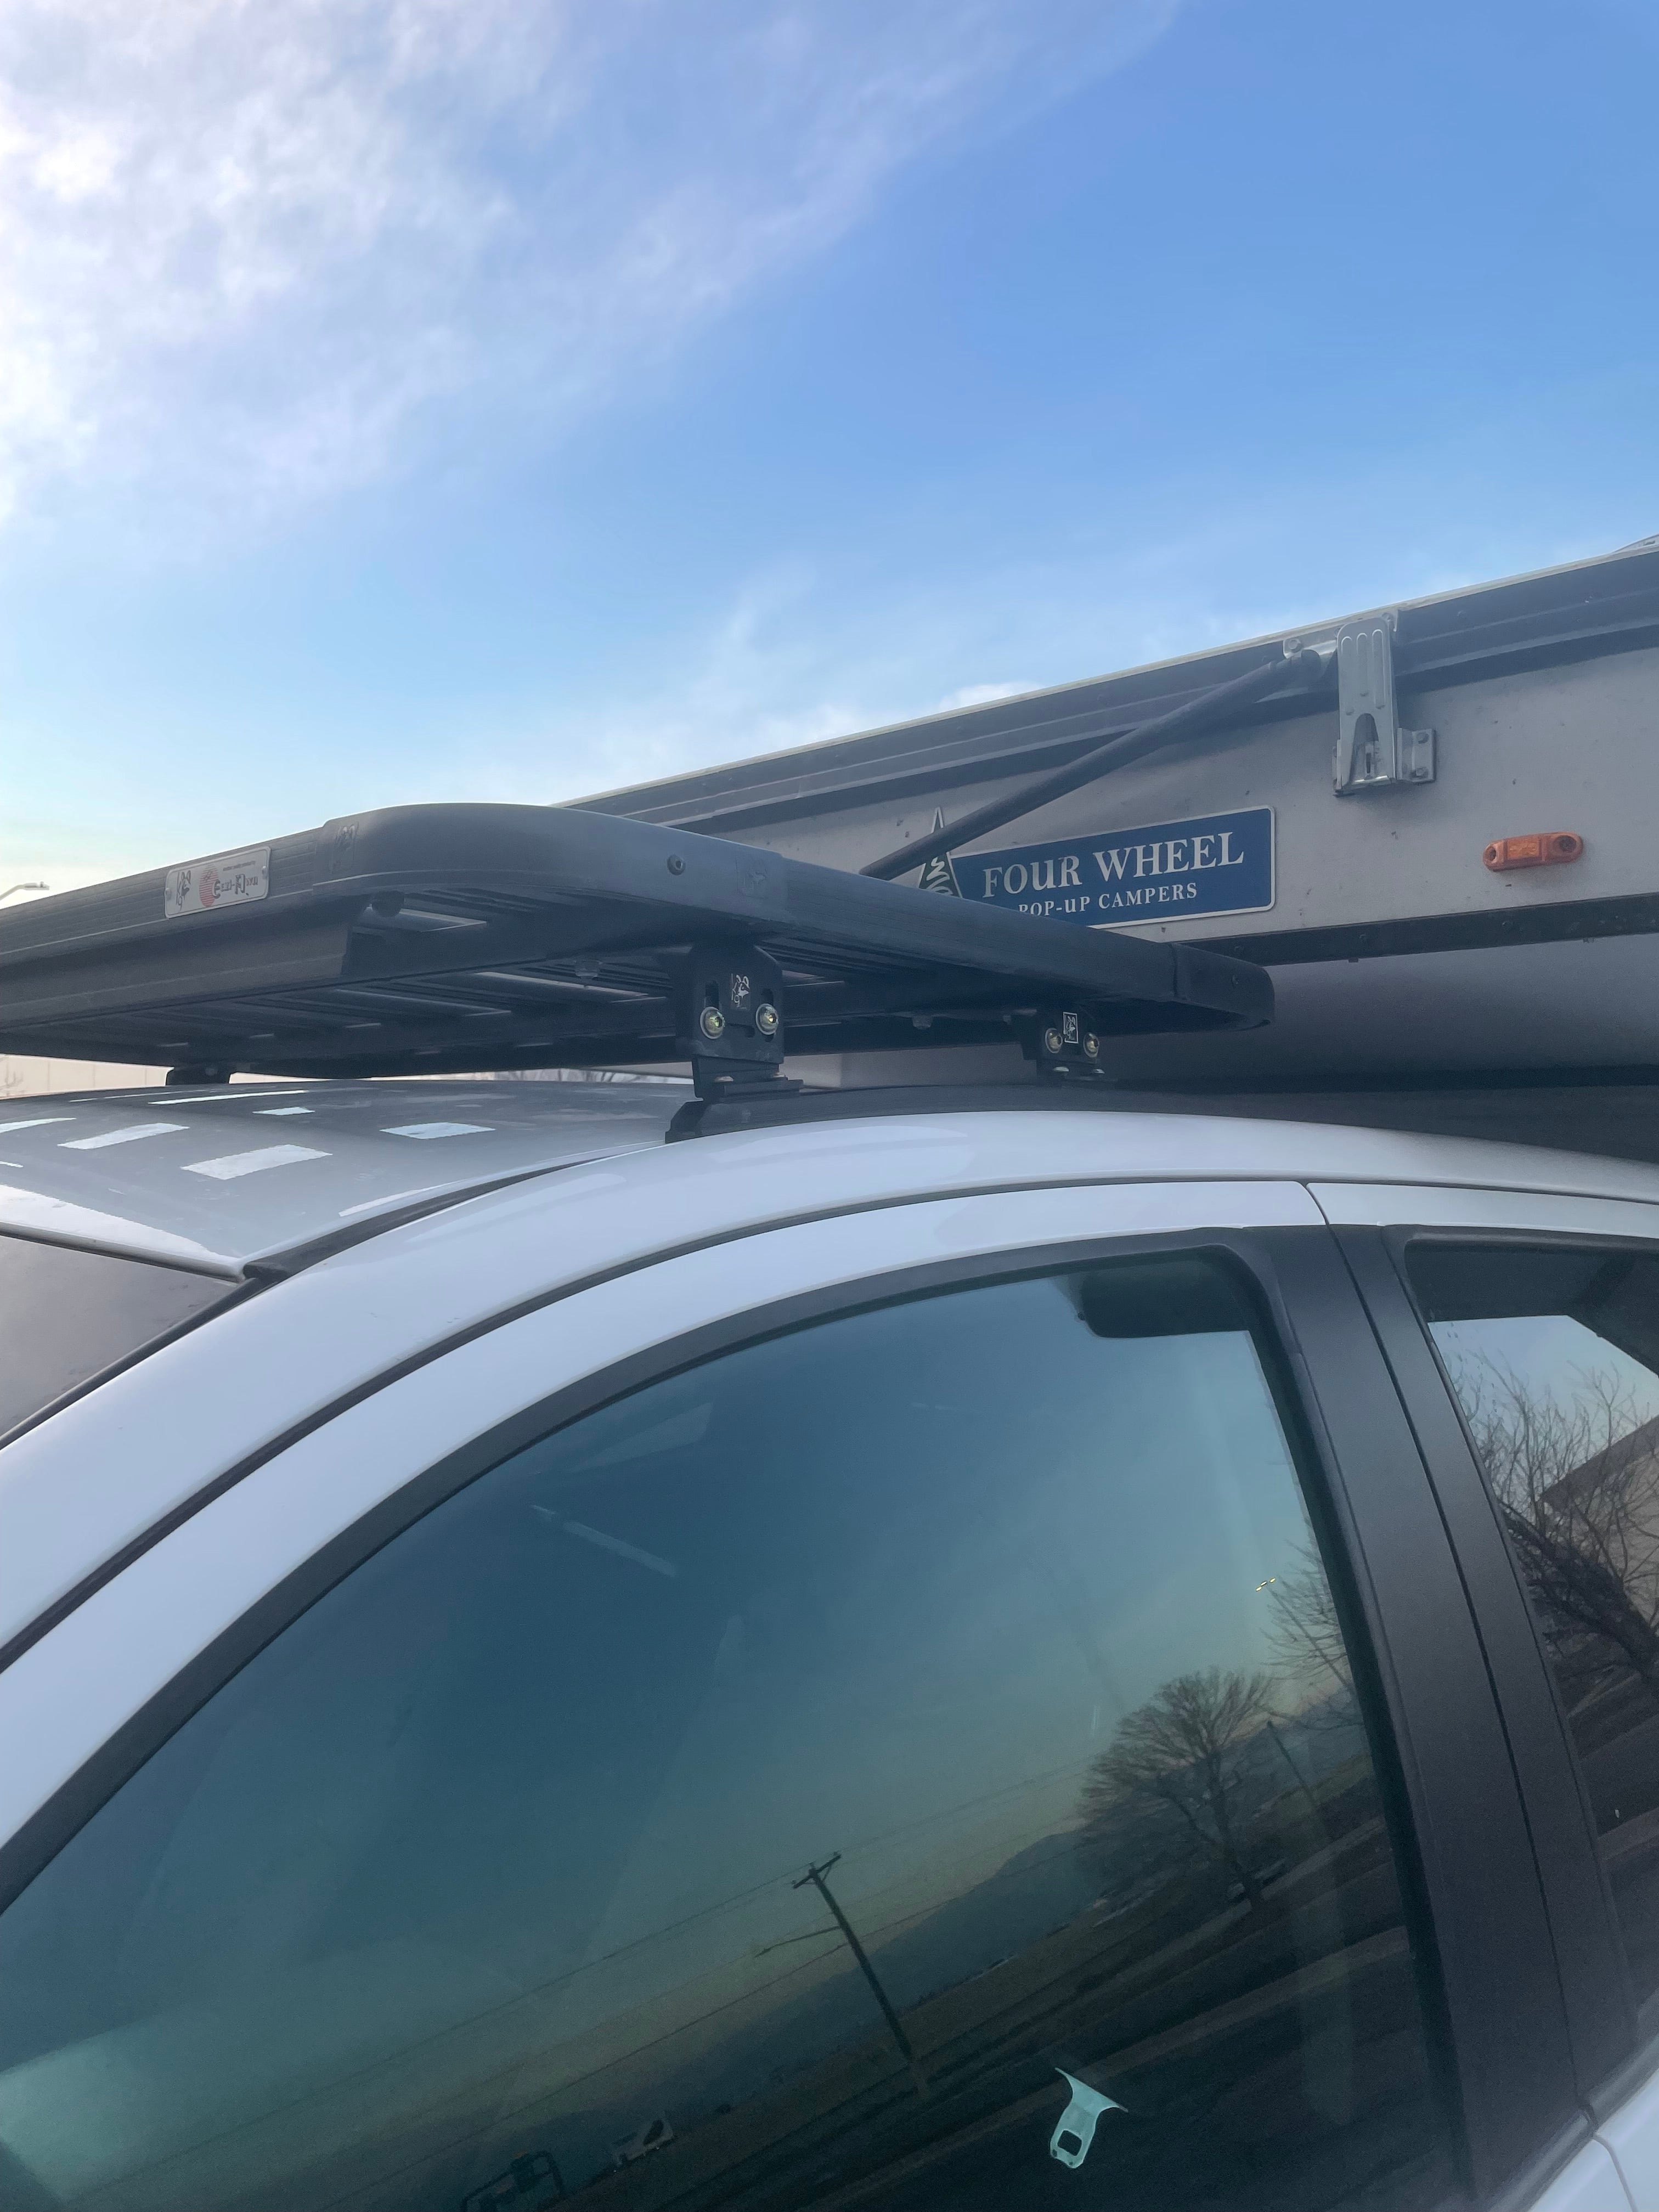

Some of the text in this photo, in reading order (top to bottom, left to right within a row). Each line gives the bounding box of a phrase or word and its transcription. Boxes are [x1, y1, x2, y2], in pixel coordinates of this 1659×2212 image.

[983, 832, 1244, 898] FOUR WHEEL
[1018, 882, 1197, 917] POP-UP CAMPERS
